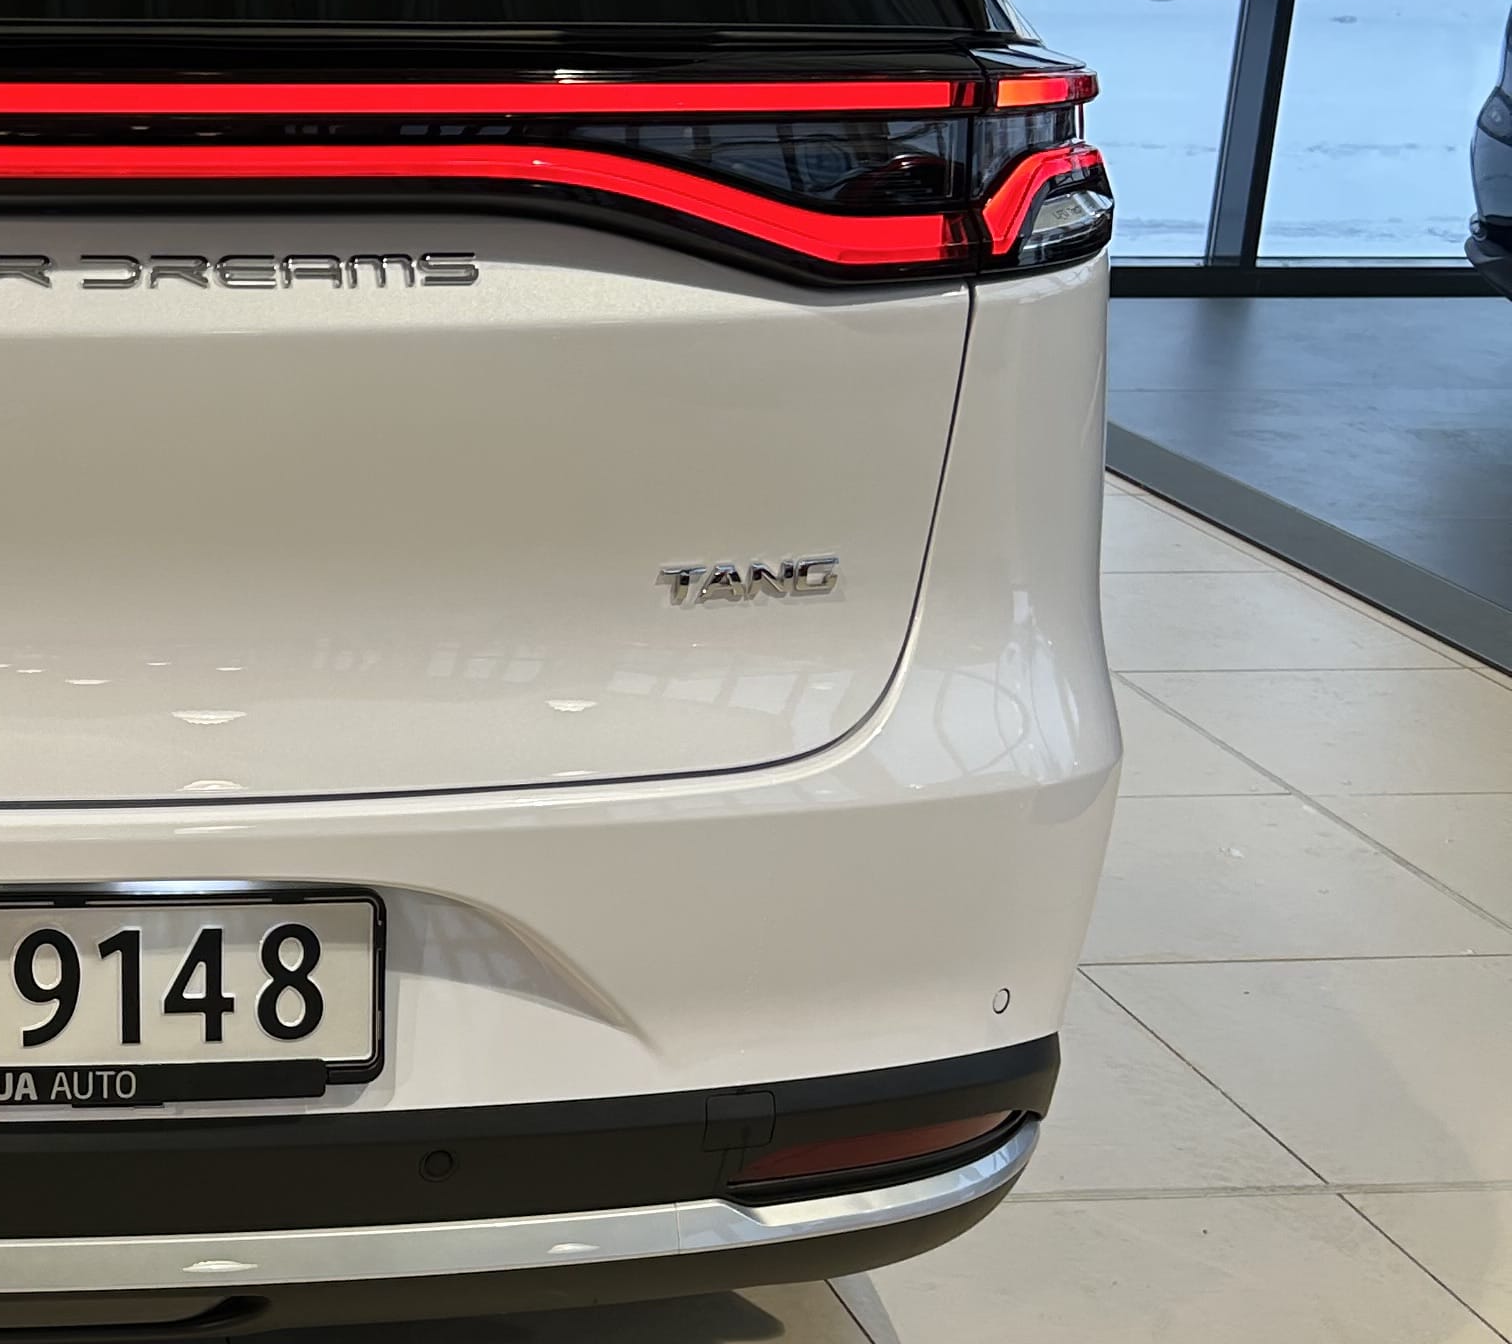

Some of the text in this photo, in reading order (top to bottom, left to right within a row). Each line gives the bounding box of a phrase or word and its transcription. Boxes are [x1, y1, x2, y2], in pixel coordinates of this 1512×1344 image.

[80, 252, 479, 289] DREAMS
[656, 556, 839, 606] TANG
[50, 1070, 137, 1100] AUTO
